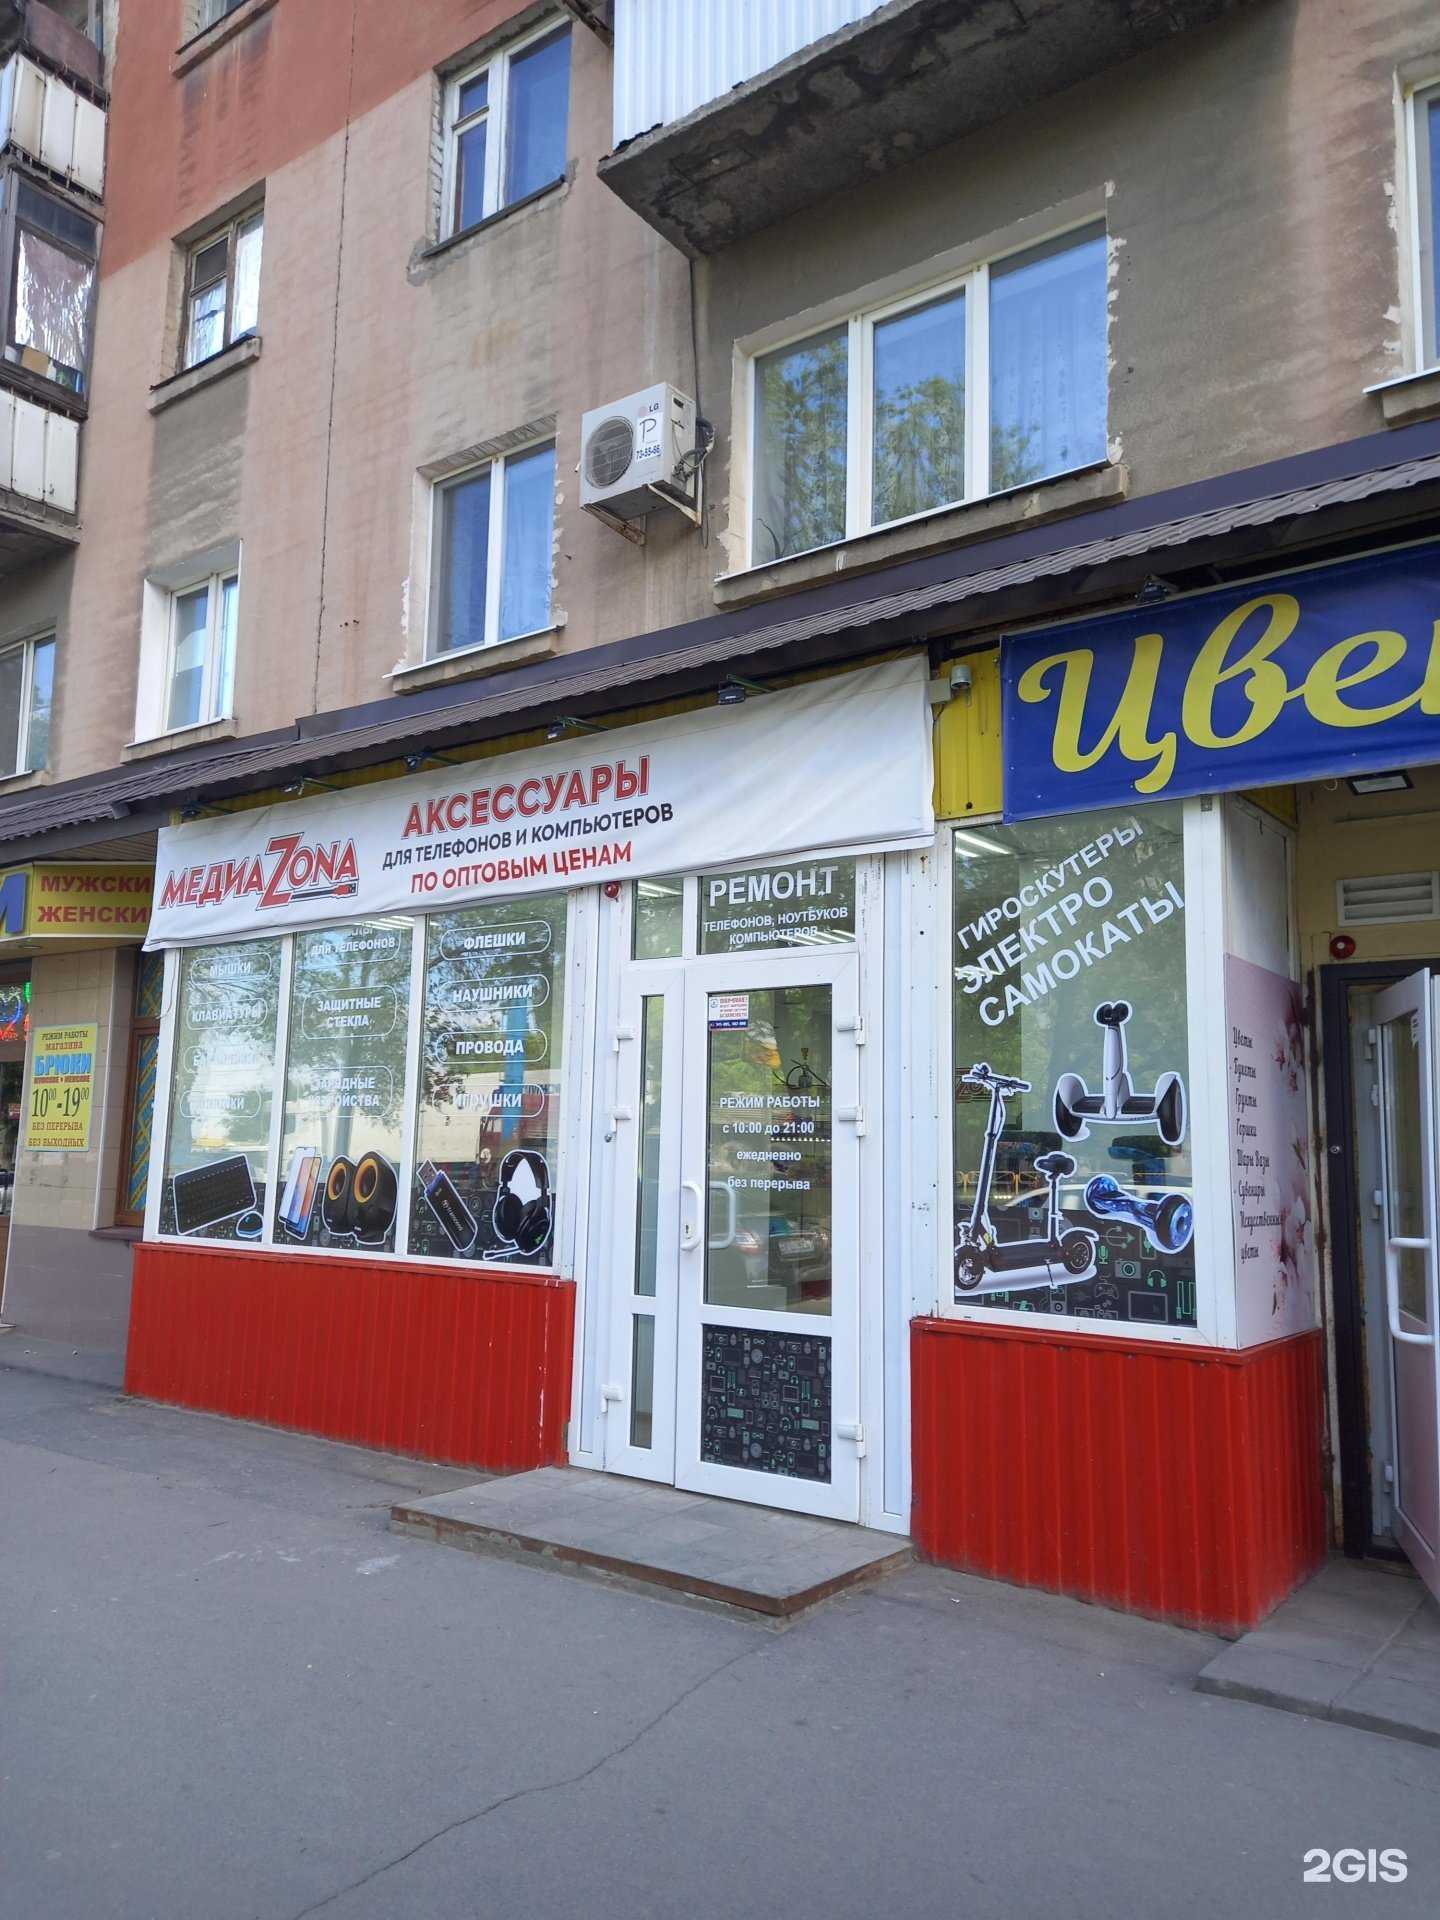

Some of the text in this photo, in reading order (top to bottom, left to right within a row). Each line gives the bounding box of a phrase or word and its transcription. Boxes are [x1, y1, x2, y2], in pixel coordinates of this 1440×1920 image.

[648, 402, 659, 412] LG
[1017, 593, 1440, 795] Цве
[401, 755, 650, 840] АКСЕССУАРЫ
[382, 803, 674, 871] ДЛЯ ТЕЛЕФОНОВ И КОМПЬЮТЕРОВ
[411, 840, 632, 893] ПО ОПТОВЫМ ЦЕНАМ
[709, 866, 839, 907] РЕМОНТ
[957, 815, 1144, 950] ГИРОСКУТЕРЫ
[778, 906, 848, 925] НОУТБУКОВ
[463, 931, 526, 949] ФЛЕШКИ
[729, 926, 818, 945] КОМПЬЮТЕРОВ
[961, 876, 1113, 994] ЭЛЕКТРО
[978, 881, 1185, 1026] САМОКАТЫ
[453, 983, 533, 1003] НАУШНИКИ
[317, 996, 382, 1013] ЗАЩИТНЫЕ
[327, 1014, 370, 1028] СТЕКЛА
[456, 1039, 525, 1057] ПРОВОДА
[34, 1053, 92, 1076] БРЮКИ
[720, 1096, 820, 1108] РЕЖИМ РАБОТЫ
[733, 1122, 762, 1134] 10:00
[764, 1124, 780, 1135] до
[783, 1122, 814, 1134] 21:00
[736, 1151, 802, 1162] ежедневно
[727, 1176, 810, 1191] без перерыва
